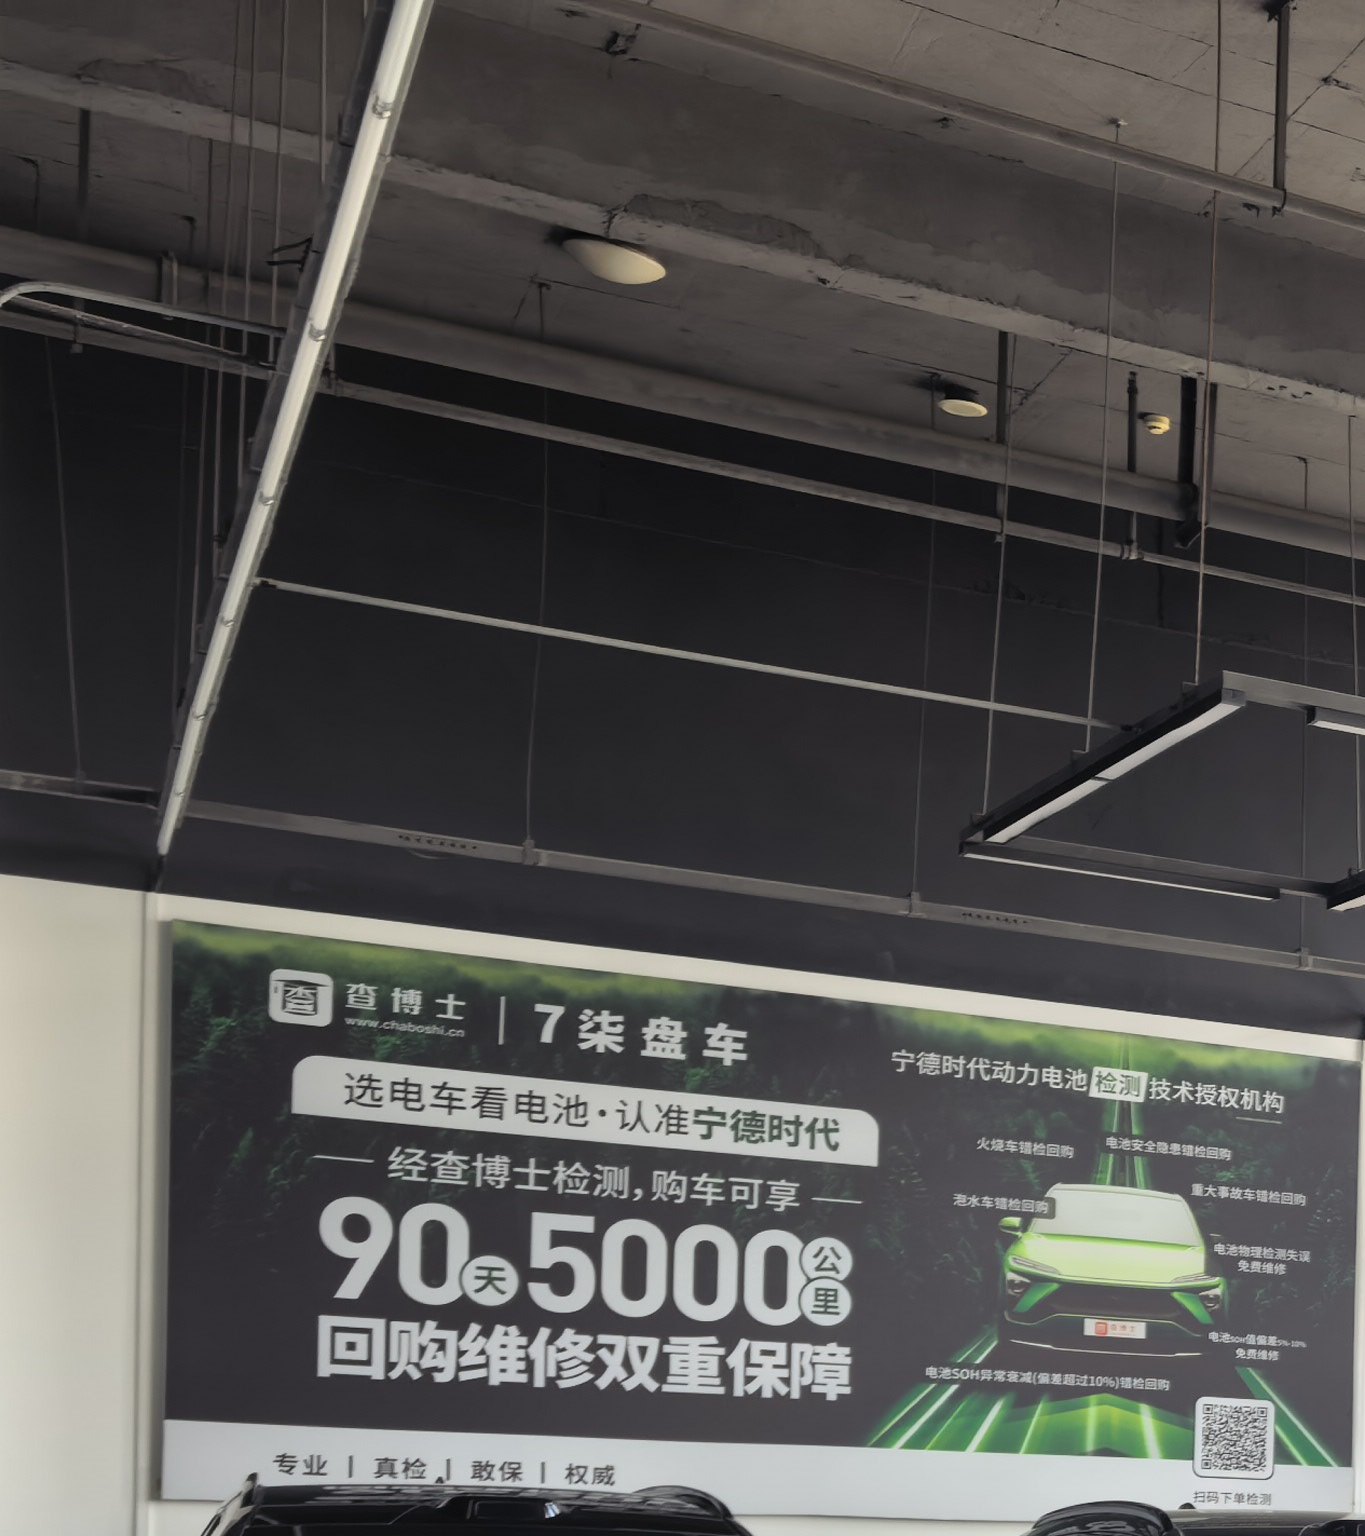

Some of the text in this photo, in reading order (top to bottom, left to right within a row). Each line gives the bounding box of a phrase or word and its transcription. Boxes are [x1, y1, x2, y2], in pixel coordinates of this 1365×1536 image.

[344, 1017, 465, 1038] www.chaboshi.cn
[345, 983, 748, 1066] 查博士 7柒盘车
[976, 1137, 1074, 1159] 火烧车错检回购
[1238, 1260, 1287, 1276] 免费维修
[316, 1314, 853, 1401] 回购维修双重保障
[273, 1452, 616, 1487] 专业 真检 敢保 权威
[1193, 1491, 1272, 1506] 扫码下单检测
